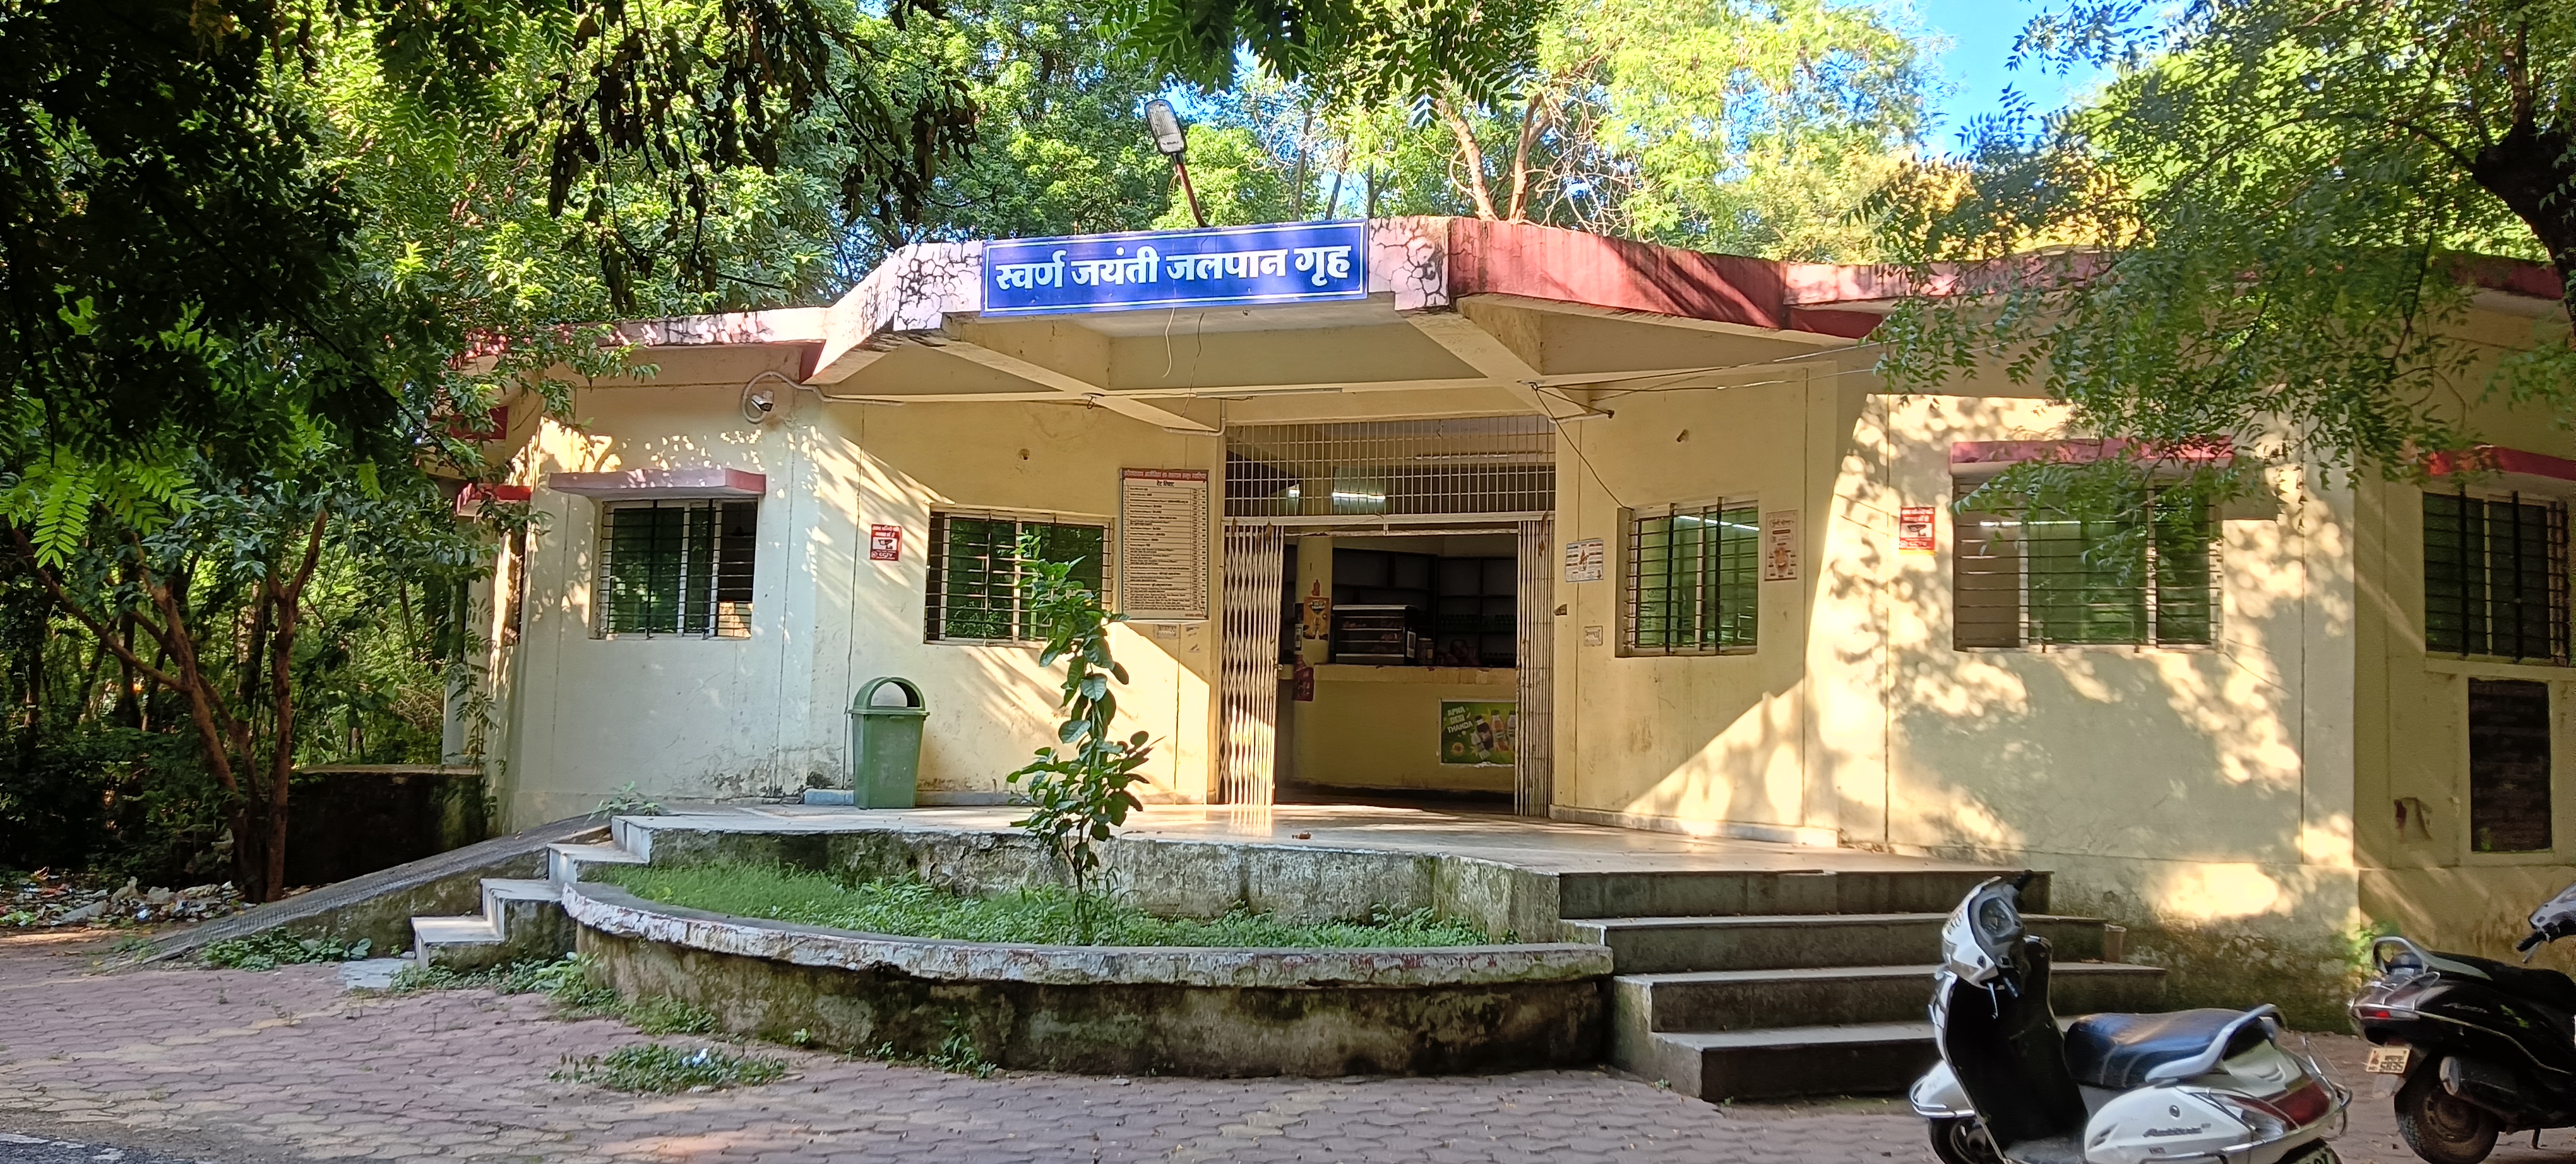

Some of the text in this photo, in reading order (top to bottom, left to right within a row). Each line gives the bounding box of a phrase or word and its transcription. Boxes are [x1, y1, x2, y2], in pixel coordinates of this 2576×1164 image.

[995, 245, 1352, 290] स्वर्ण जयंती जलपान गृह
[1447, 706, 1465, 716] APNA
[1450, 715, 1465, 724] DESI
[1447, 721, 1473, 733] THANDA
